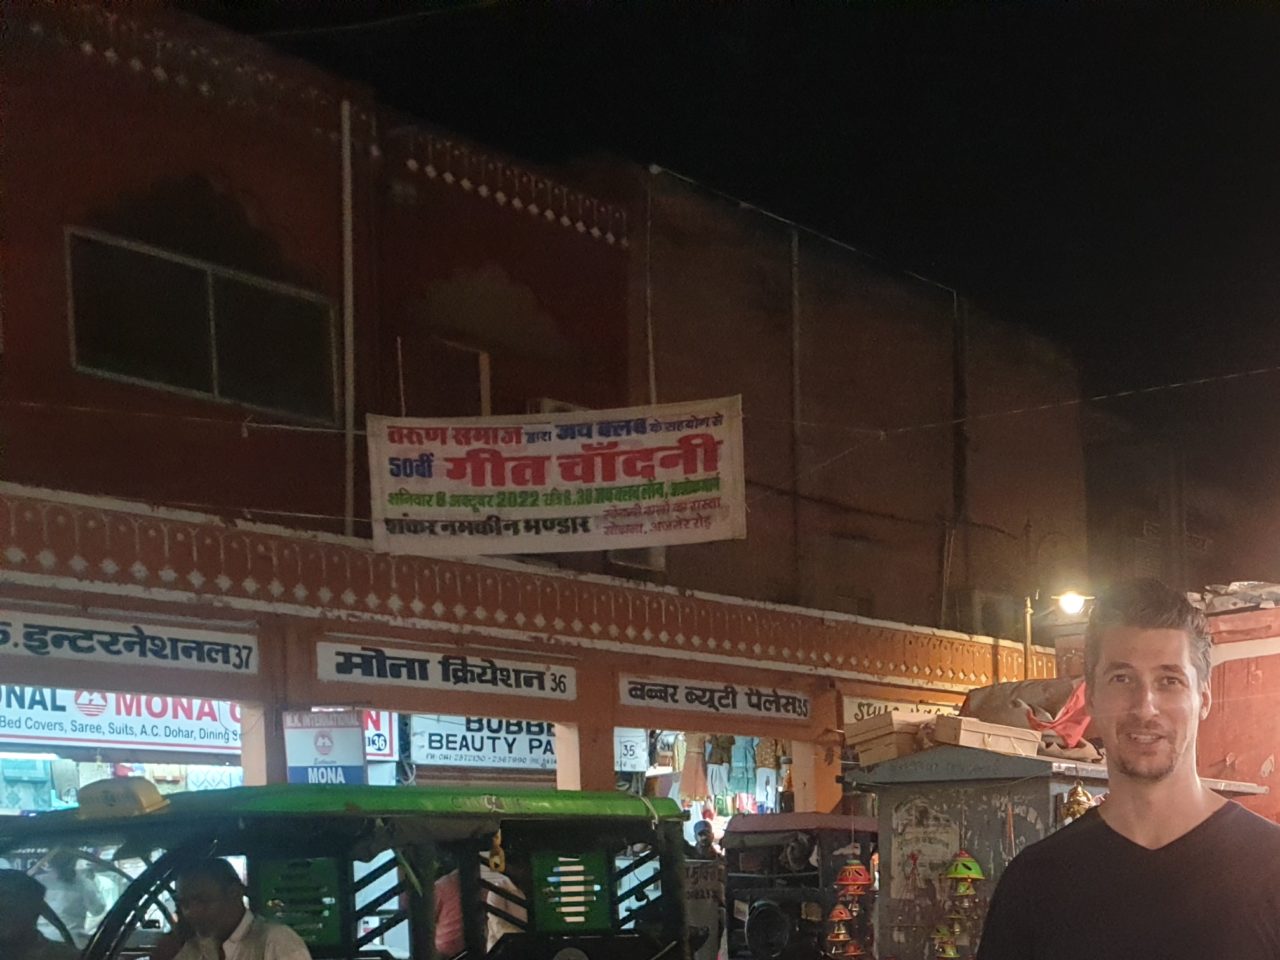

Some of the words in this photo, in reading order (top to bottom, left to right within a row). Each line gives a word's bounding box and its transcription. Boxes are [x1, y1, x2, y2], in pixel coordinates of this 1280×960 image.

[711, 412, 724, 427] से
[443, 448, 551, 488] गीत
[497, 490, 540, 508] 2022
[23, 624, 232, 665] इन्टरनेशनल
[232, 645, 253, 670] 37
[334, 646, 430, 681] मोना
[549, 673, 568, 694] 36
[0, 685, 67, 713] NAL
[115, 693, 218, 723] MONA
[0, 715, 21, 729] Bed
[25, 716, 67, 734] Covers,
[70, 719, 105, 736] Saree,
[108, 722, 137, 737] Suits,
[164, 724, 197, 740] Dohar,
[199, 727, 230, 744] Dining
[428, 733, 517, 755] BEAUTY
[307, 766, 345, 785] MONA
